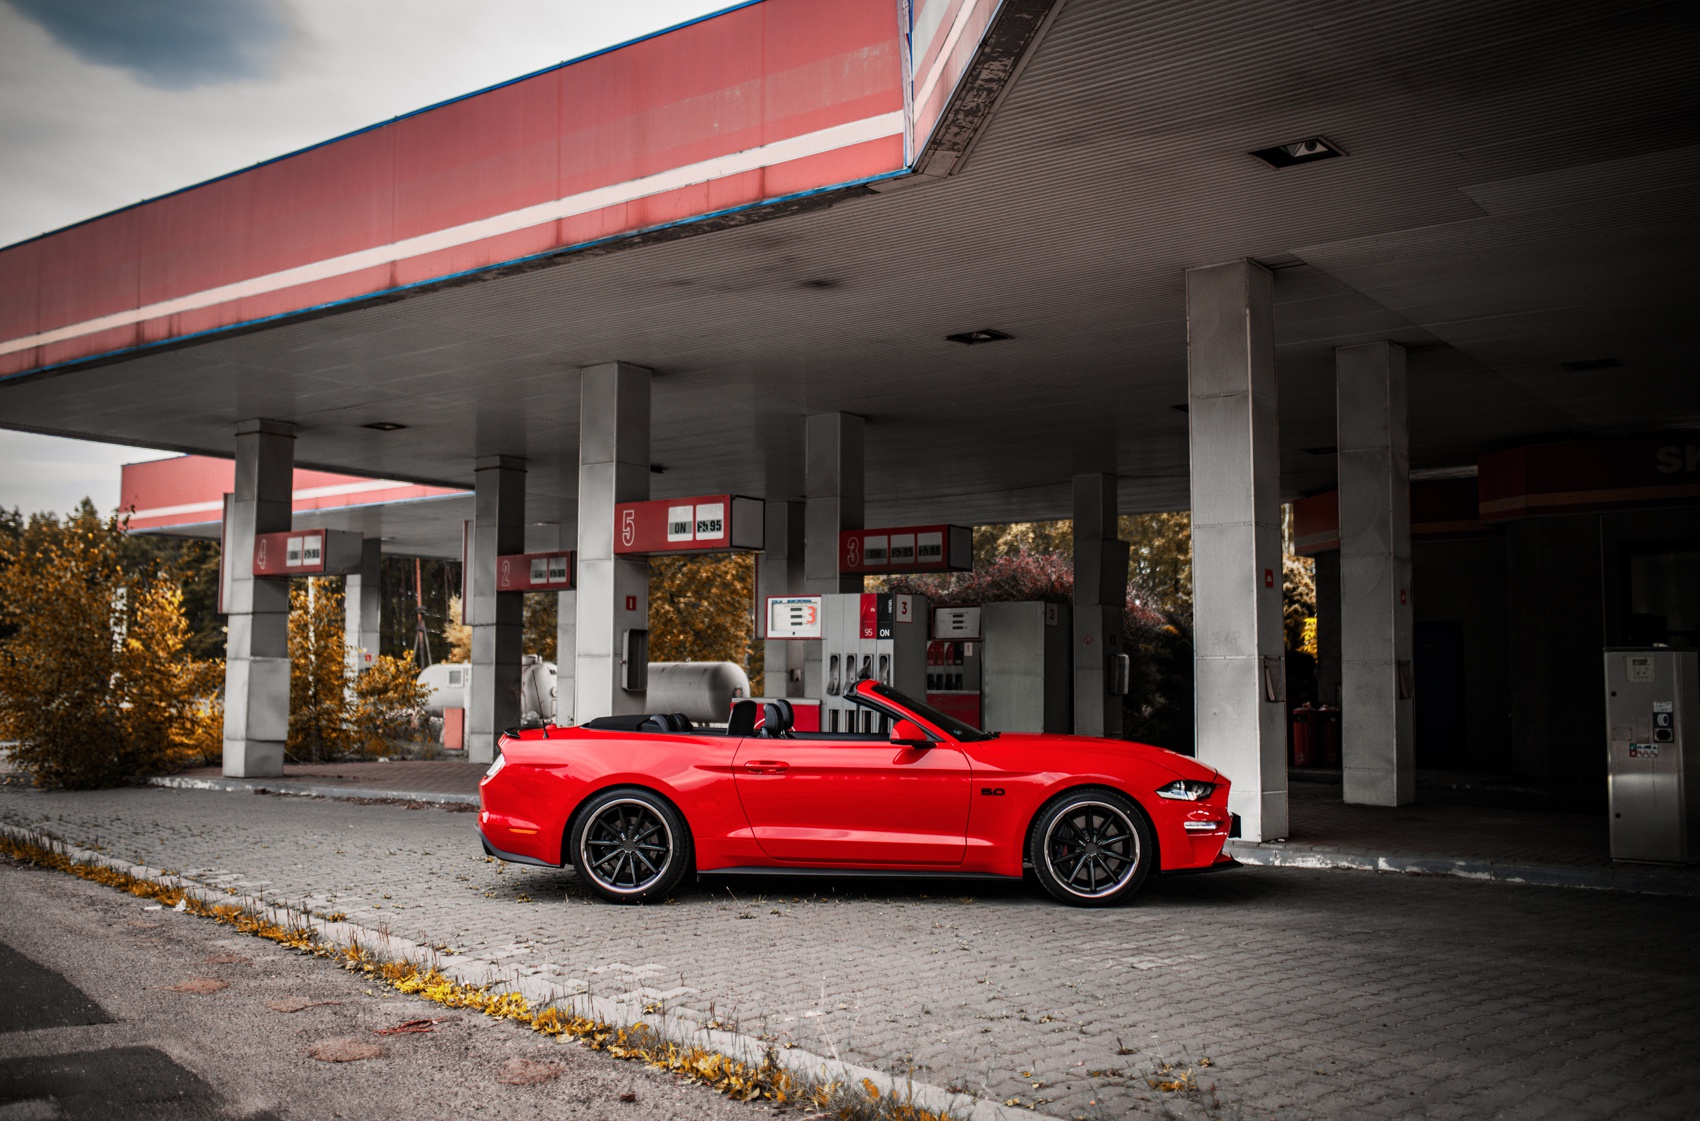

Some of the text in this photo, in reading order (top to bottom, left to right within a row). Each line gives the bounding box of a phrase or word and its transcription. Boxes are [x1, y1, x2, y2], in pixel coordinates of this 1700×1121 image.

[622, 510, 635, 546] 5
[674, 522, 686, 534] ON
[257, 539, 267, 570] 4
[847, 536, 859, 568] 3
[501, 560, 511, 587] 2
[806, 605, 817, 624] 3
[901, 601, 908, 615] 3
[1049, 608, 1055, 620] 2
[864, 628, 873, 637] 95
[879, 628, 890, 637] ON
